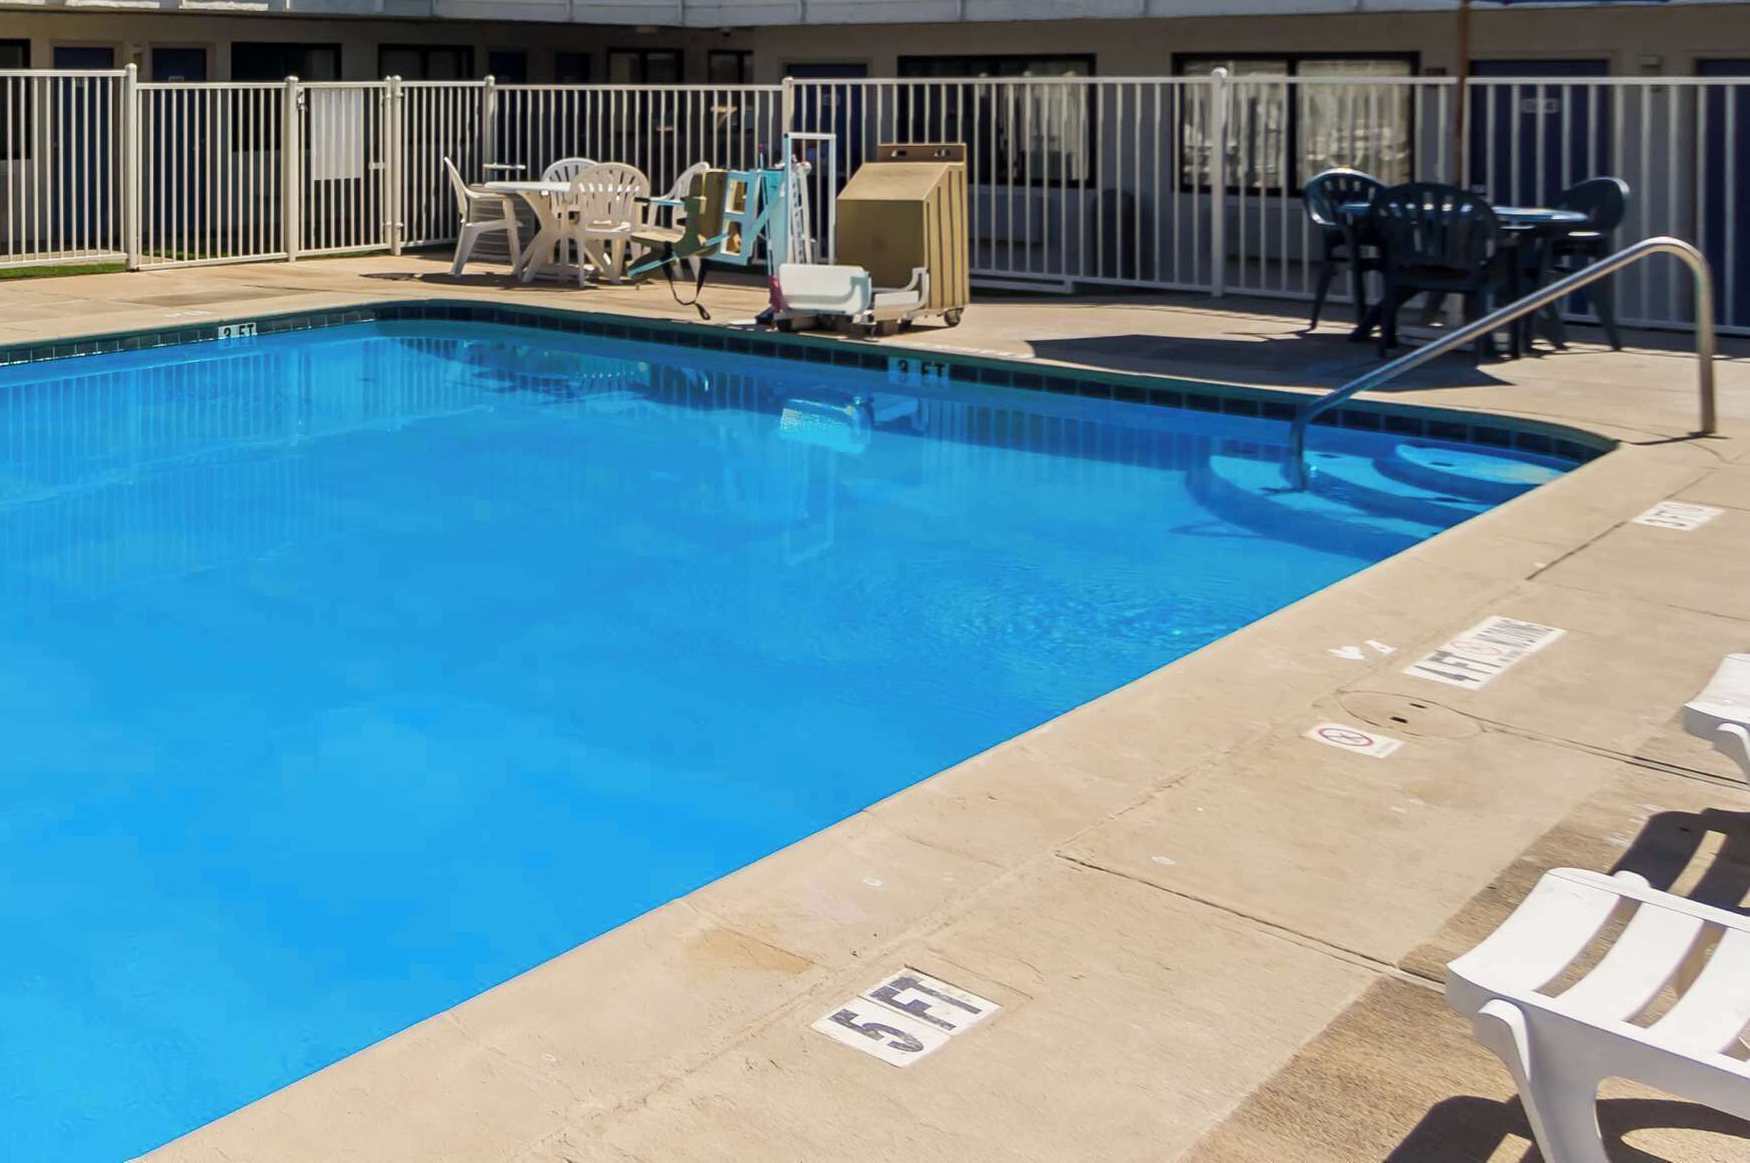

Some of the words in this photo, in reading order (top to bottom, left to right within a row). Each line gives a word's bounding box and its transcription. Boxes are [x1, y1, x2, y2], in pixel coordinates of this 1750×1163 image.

[1413, 665, 1482, 683] 4
[1424, 649, 1503, 675] FT
[869, 976, 983, 1031] FT
[827, 1008, 924, 1053] 5
